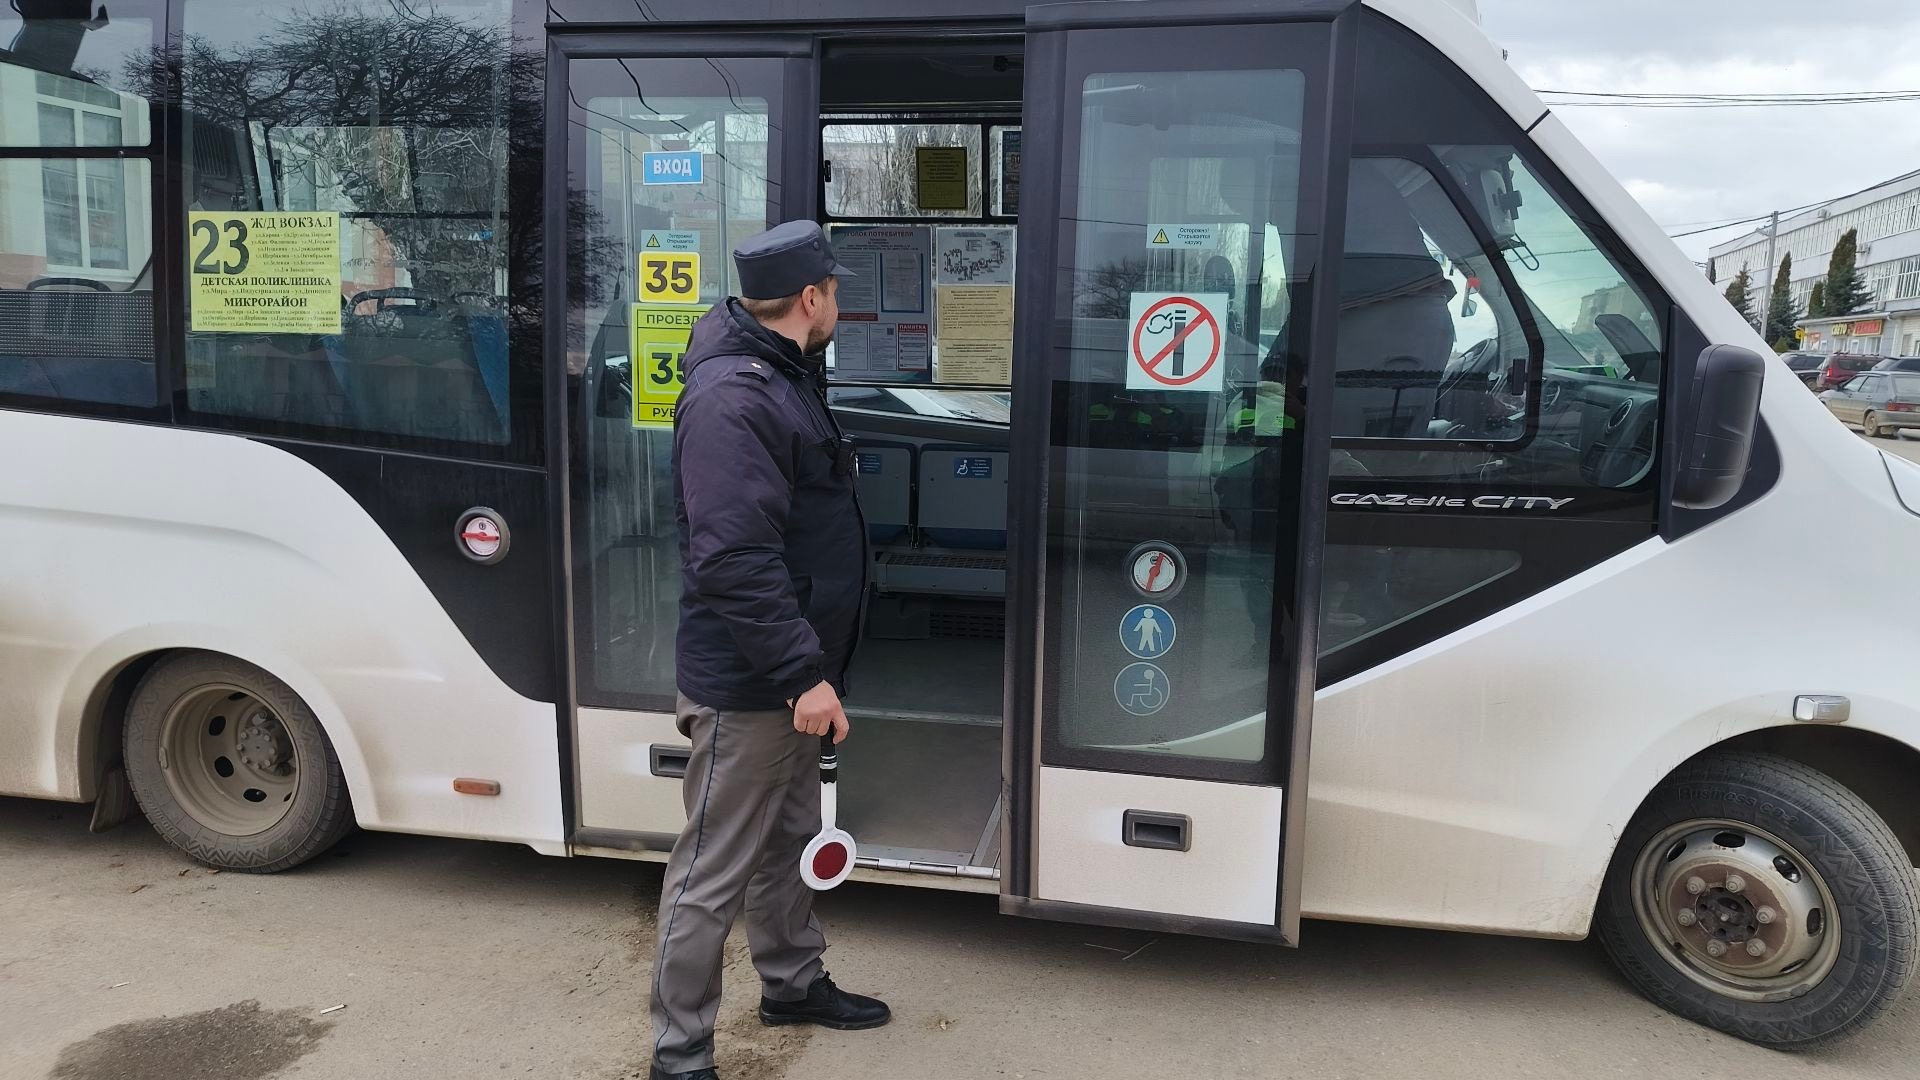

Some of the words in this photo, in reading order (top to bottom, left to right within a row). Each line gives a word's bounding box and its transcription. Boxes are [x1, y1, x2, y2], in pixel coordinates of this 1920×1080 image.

[653, 158, 692, 177] ВХОД
[251, 217, 276, 230] Ж/Д
[280, 216, 332, 229] ВОКЗАЛ
[192, 219, 250, 275] 23
[201, 276, 248, 287] ДЕТСКАЯ
[251, 276, 332, 286] ПОЛИКЛИНИКА
[646, 261, 693, 293] 35
[224, 296, 308, 308] МИКРОРАЙОН
[646, 314, 700, 327] ПРОЕЗД
[1330, 493, 1467, 507] GAZelle
